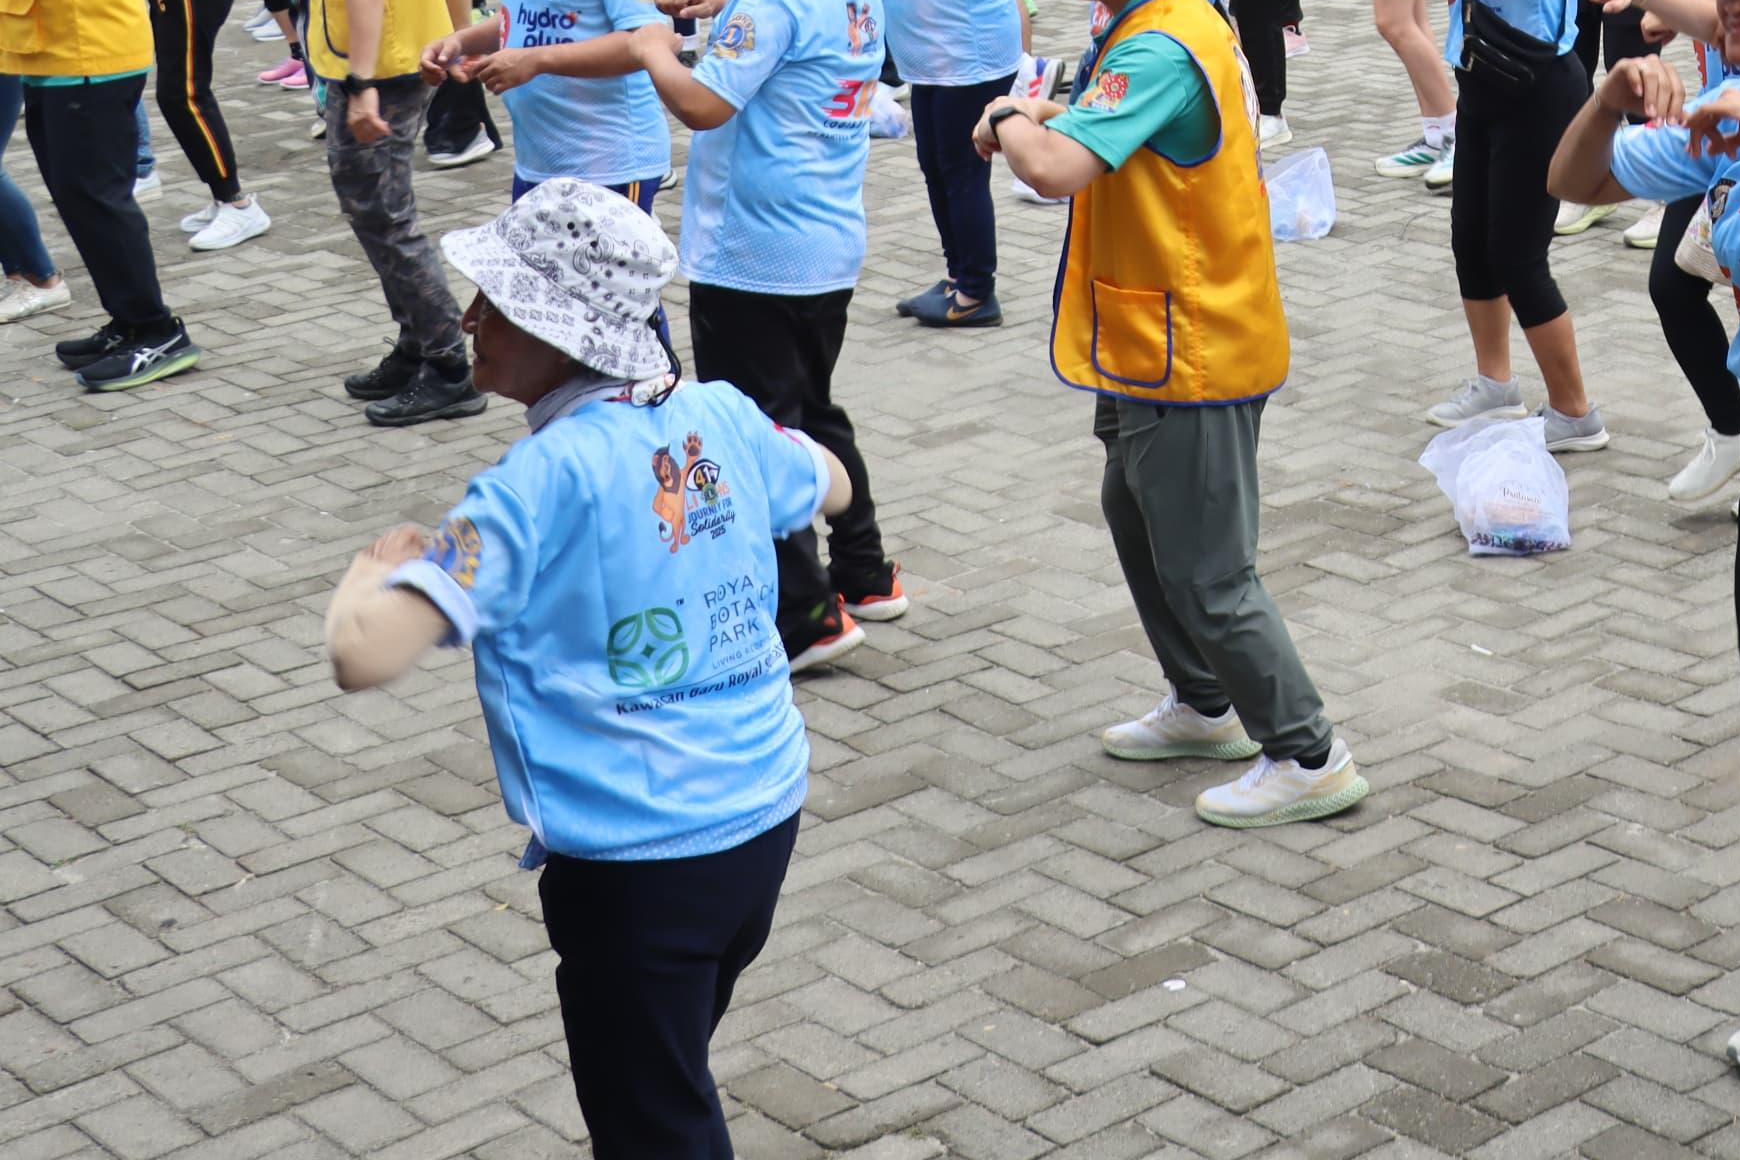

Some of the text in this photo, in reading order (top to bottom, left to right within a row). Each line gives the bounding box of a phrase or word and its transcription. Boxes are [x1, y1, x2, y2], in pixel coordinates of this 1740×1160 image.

[517, 2, 576, 31] hydro
[708, 617, 762, 653] PARK
[616, 690, 684, 717] Kawasan
[728, 664, 764, 689] Royal
